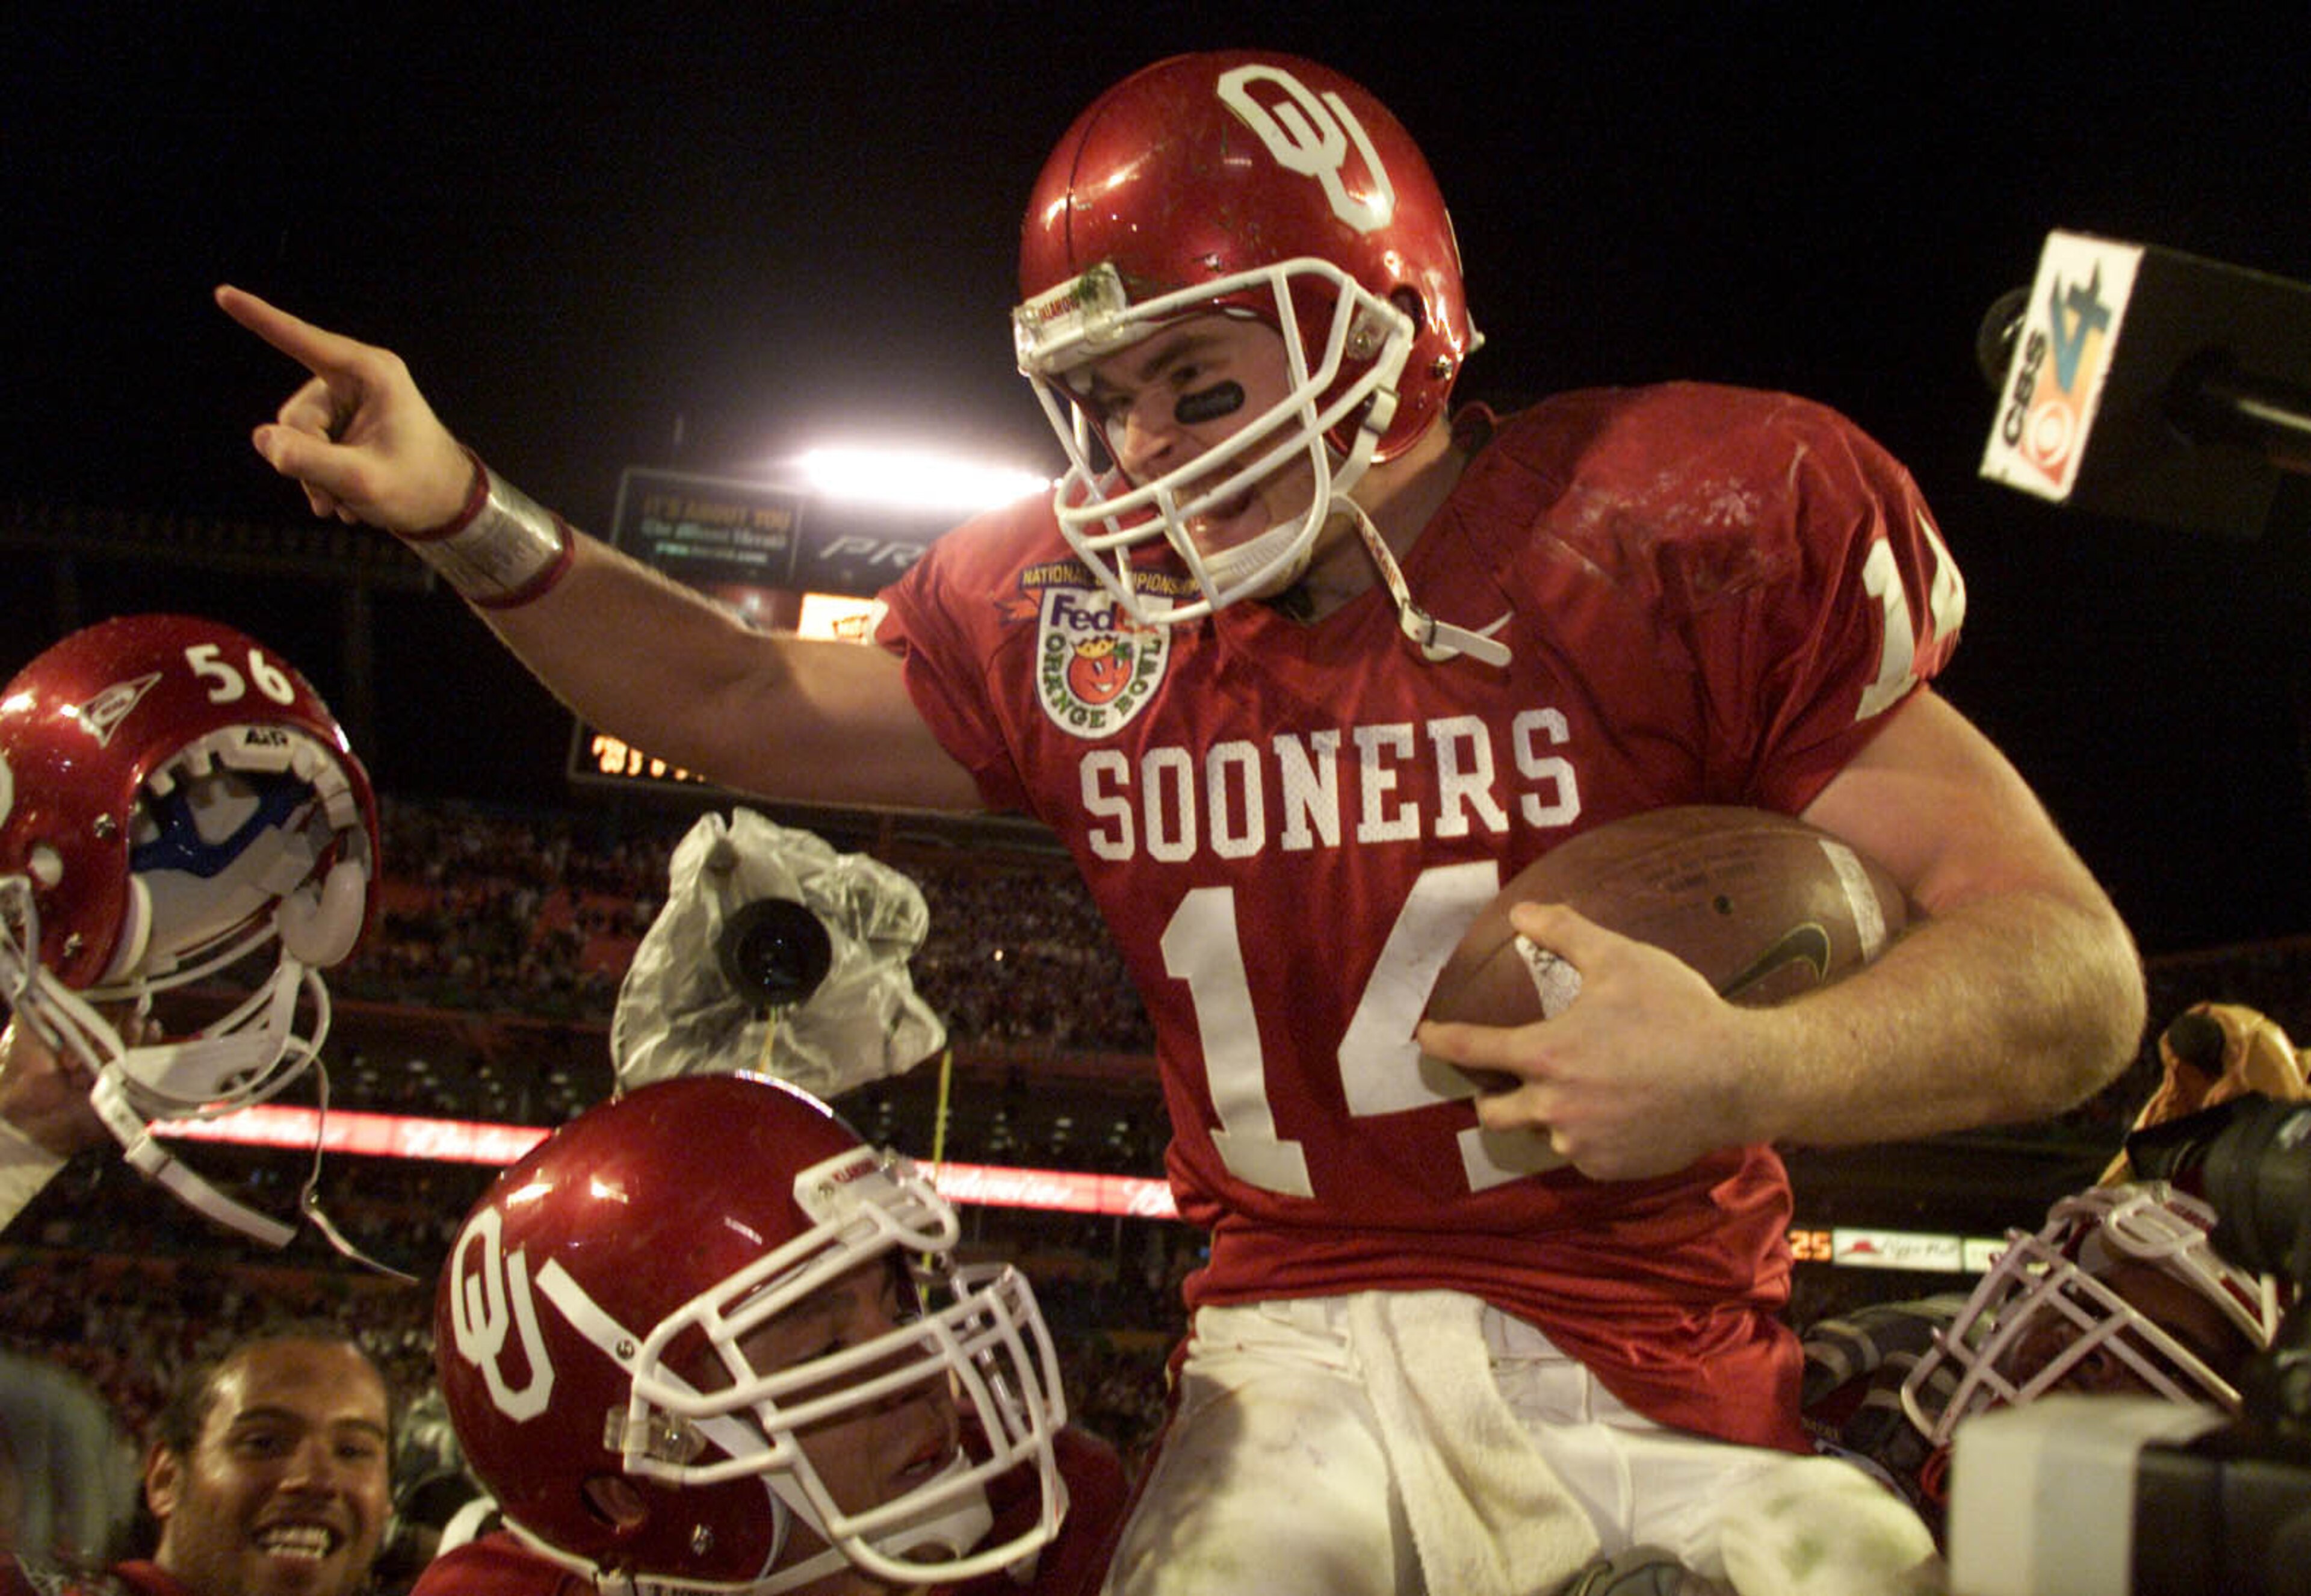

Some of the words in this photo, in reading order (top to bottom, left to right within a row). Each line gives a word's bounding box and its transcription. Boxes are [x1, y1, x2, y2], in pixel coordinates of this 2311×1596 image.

[1217, 64, 1396, 235] OU
[2002, 329, 2047, 448] CBS
[185, 643, 294, 705] 56
[1044, 633, 1106, 728] ORANGE
[1078, 708, 1582, 863] SOONERS
[1160, 860, 1574, 1199] 14
[450, 1206, 555, 1423] OU
